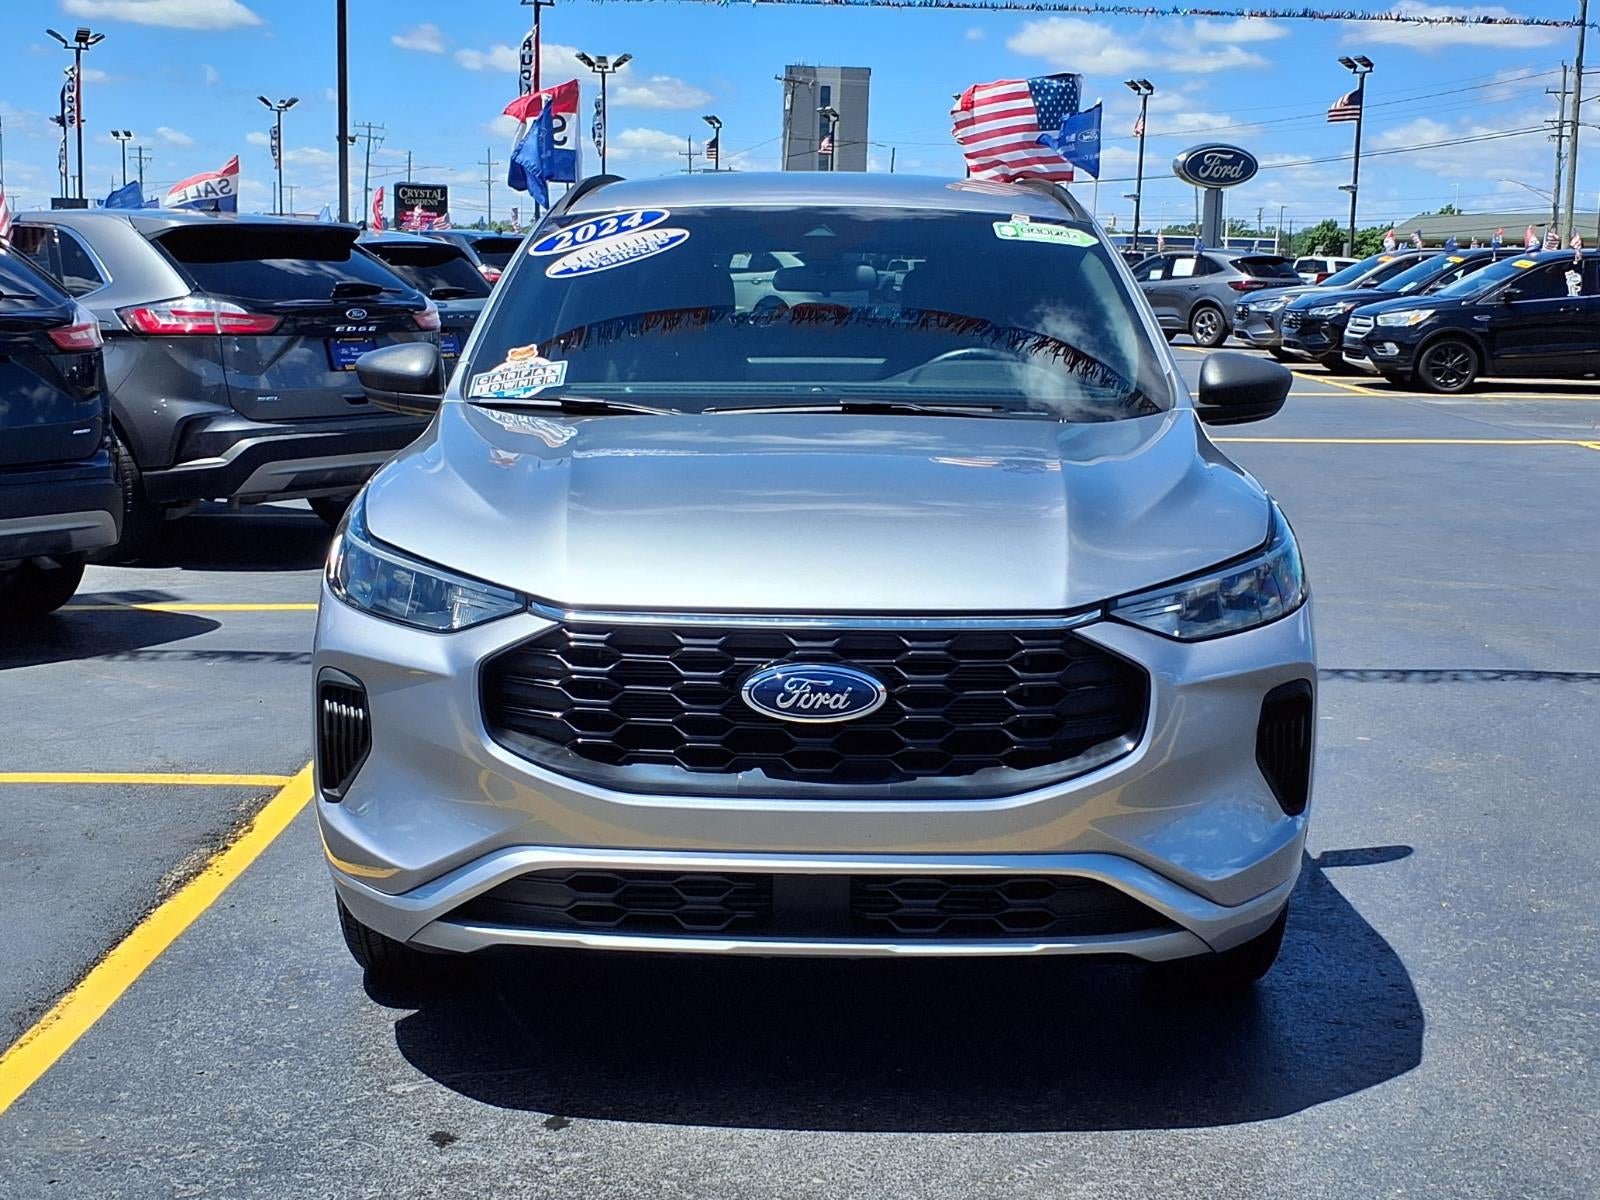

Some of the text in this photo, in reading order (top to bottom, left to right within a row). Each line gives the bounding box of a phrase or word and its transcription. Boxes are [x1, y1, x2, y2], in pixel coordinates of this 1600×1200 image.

[1198, 153, 1245, 178] Ford
[399, 187, 446, 201] CRYSTAL
[404, 198, 439, 206] GARDENS
[553, 211, 645, 251] 2024
[478, 366, 558, 385] CARFAX
[489, 374, 559, 393] OWNER
[775, 677, 853, 710] Ford
